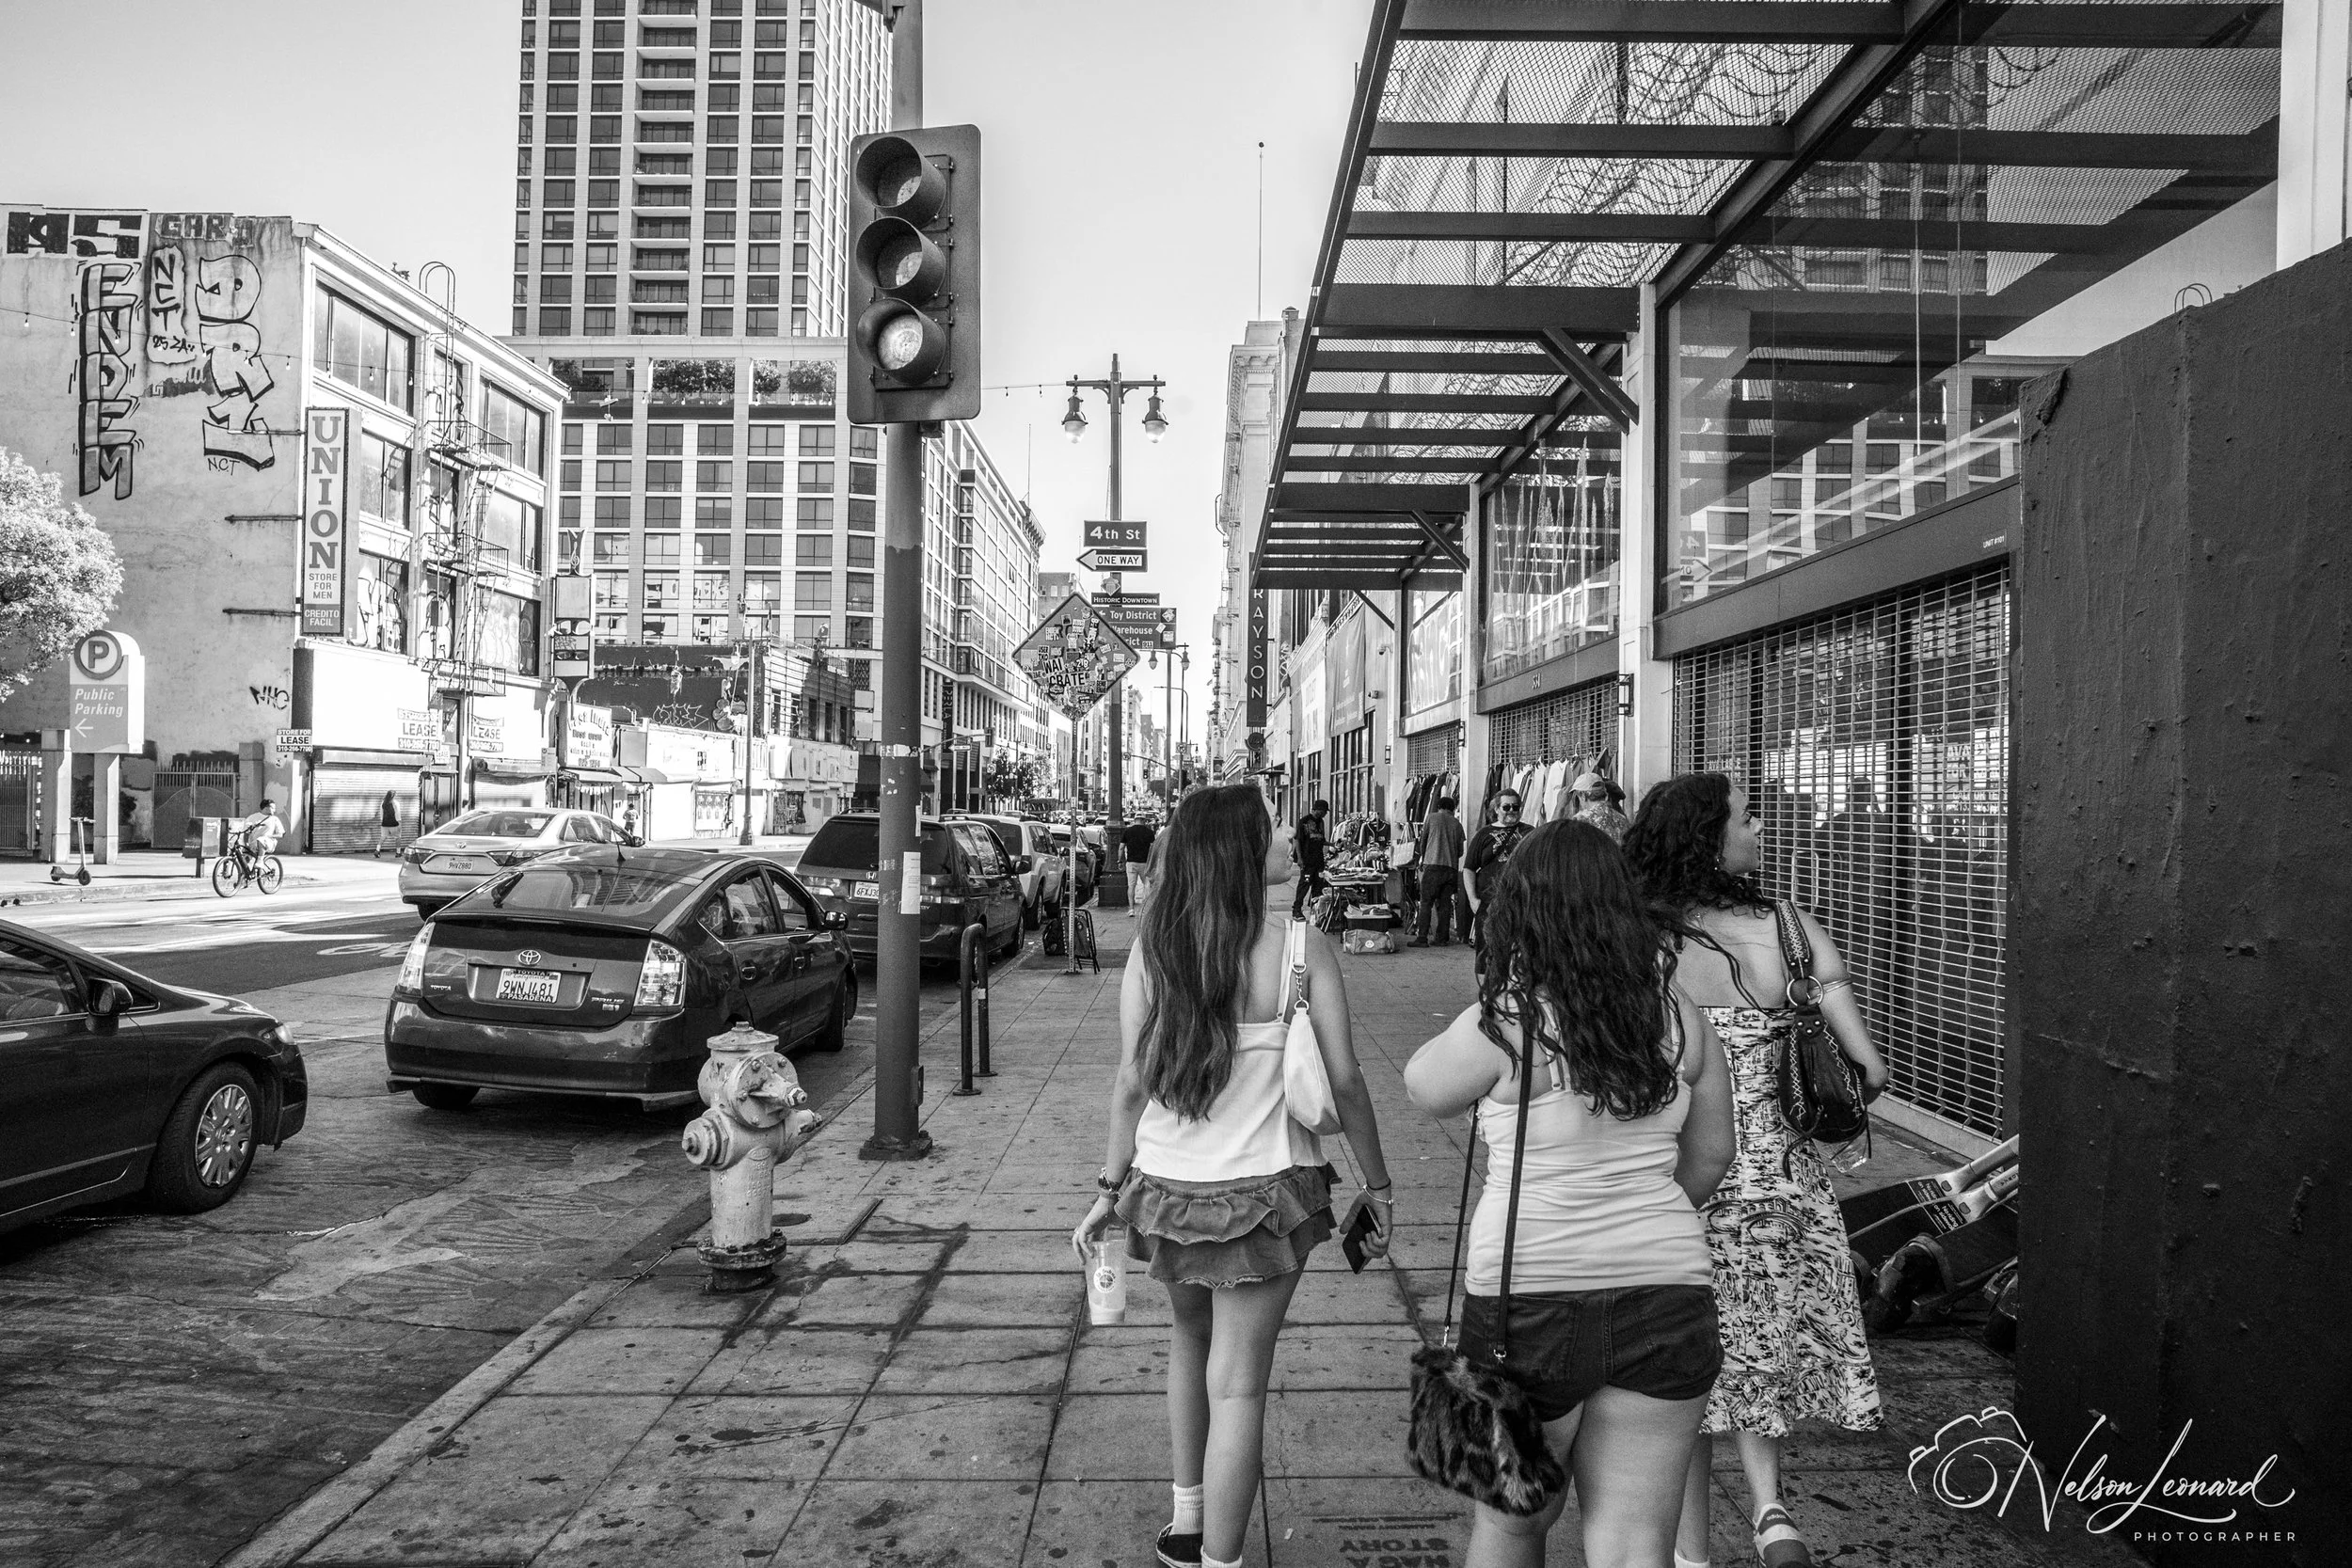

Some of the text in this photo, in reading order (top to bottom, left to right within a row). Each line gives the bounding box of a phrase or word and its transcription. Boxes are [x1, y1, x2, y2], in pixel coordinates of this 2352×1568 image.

[309, 416, 342, 569] UNION
[1089, 526, 1141, 540] 4th St
[1097, 555, 1139, 564] ONE WAY
[309, 573, 338, 581] STORE
[313, 581, 332, 591] FOR
[312, 591, 333, 599] MEN
[304, 610, 340, 618] CREDITO
[1110, 610, 1157, 620] Toy District
[309, 617, 334, 626] FACIL
[1251, 589, 1264, 700] RAYSON
[87, 641, 110, 669] P
[74, 688, 115, 701] Public
[74, 703, 123, 718] Parking
[403, 722, 437, 736] LEASE
[507, 993, 552, 1003] PASADENA
